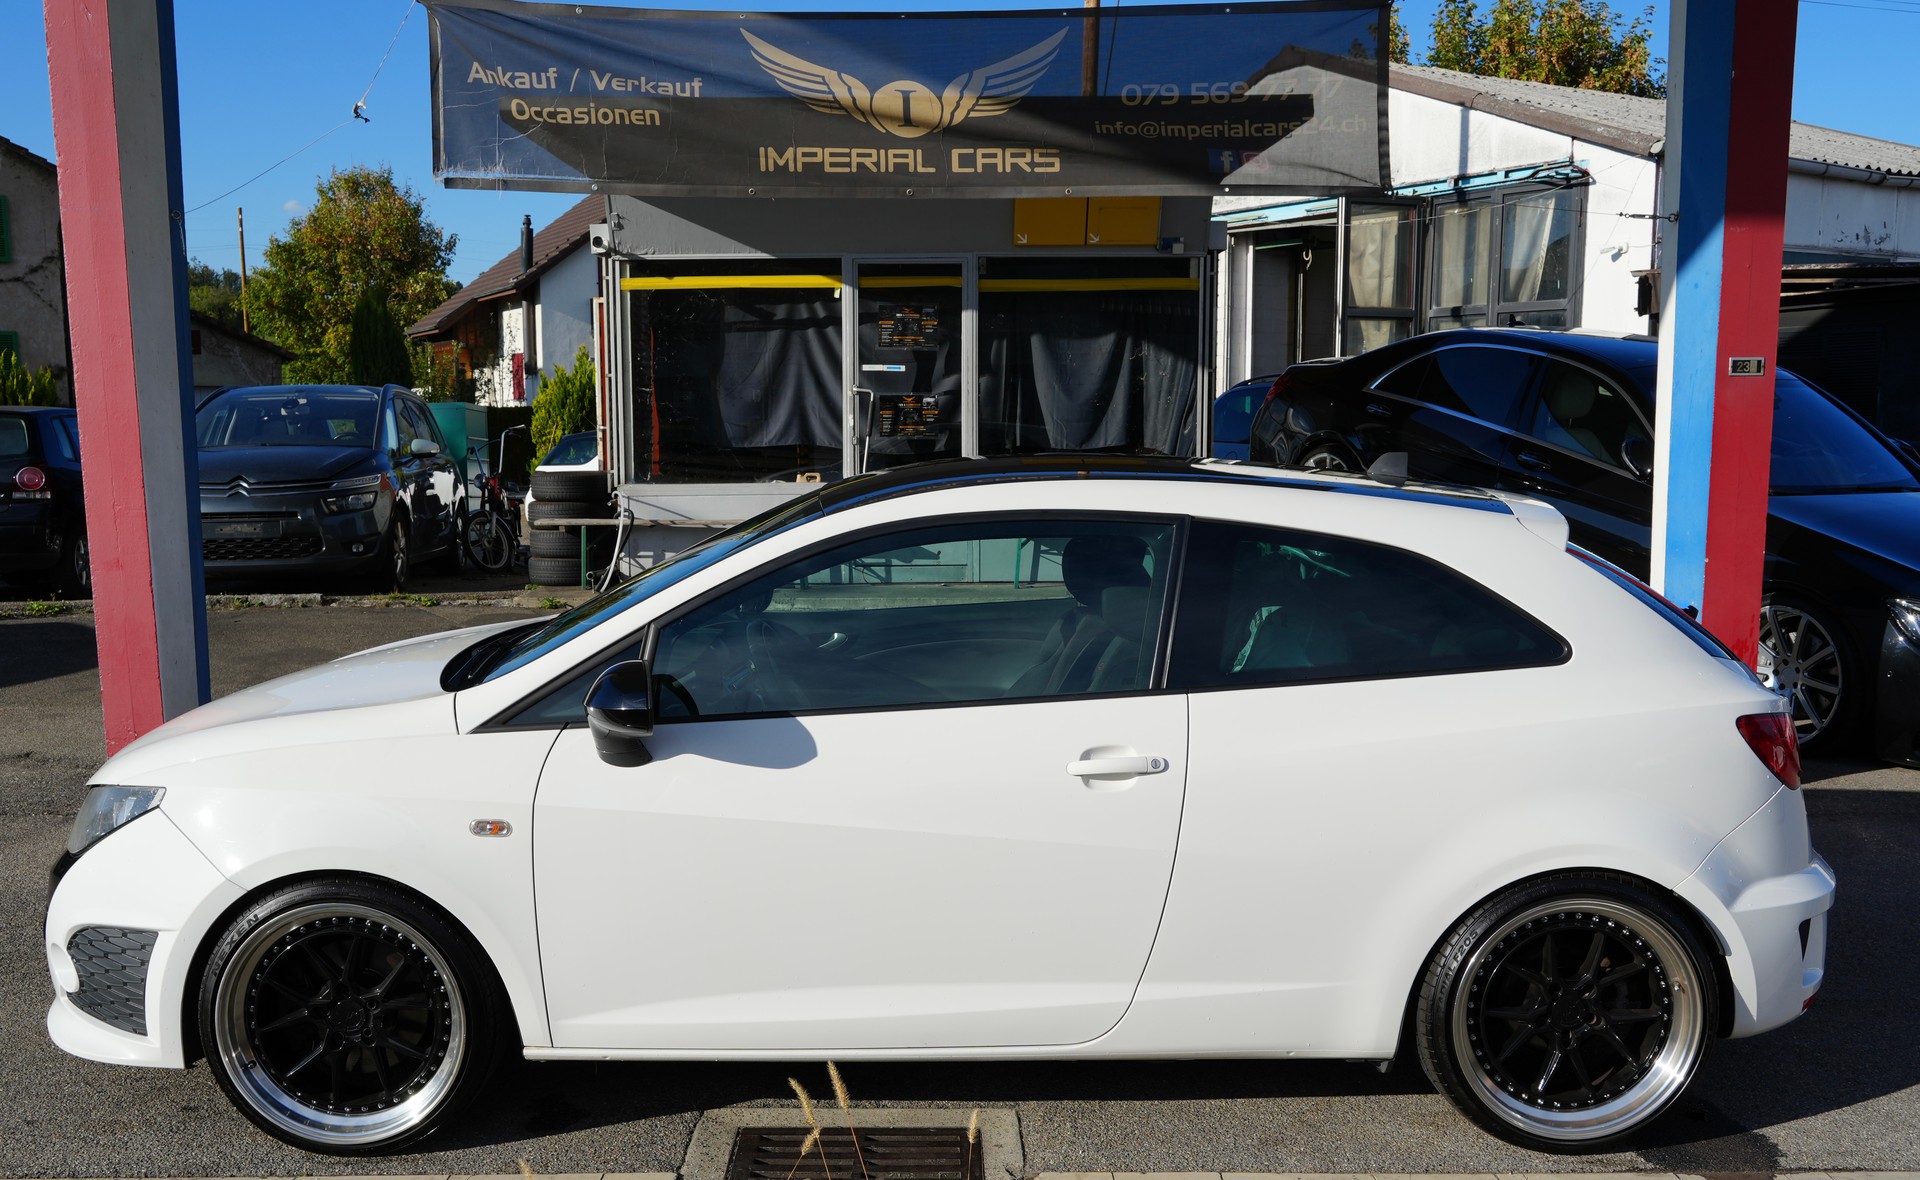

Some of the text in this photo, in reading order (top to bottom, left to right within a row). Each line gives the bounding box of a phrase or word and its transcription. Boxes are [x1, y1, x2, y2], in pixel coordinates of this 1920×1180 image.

[467, 61, 703, 98] Ankauf / Verkauf
[1121, 83, 1180, 106] 079
[1190, 81, 1250, 104] 569
[510, 98, 661, 126] Occasionen
[1094, 113, 1368, 141] info@imperialcars24.ch
[759, 146, 1061, 173] IMPERIAL CARS
[1736, 361, 1750, 372] 23
[210, 913, 260, 978] NEXEN
